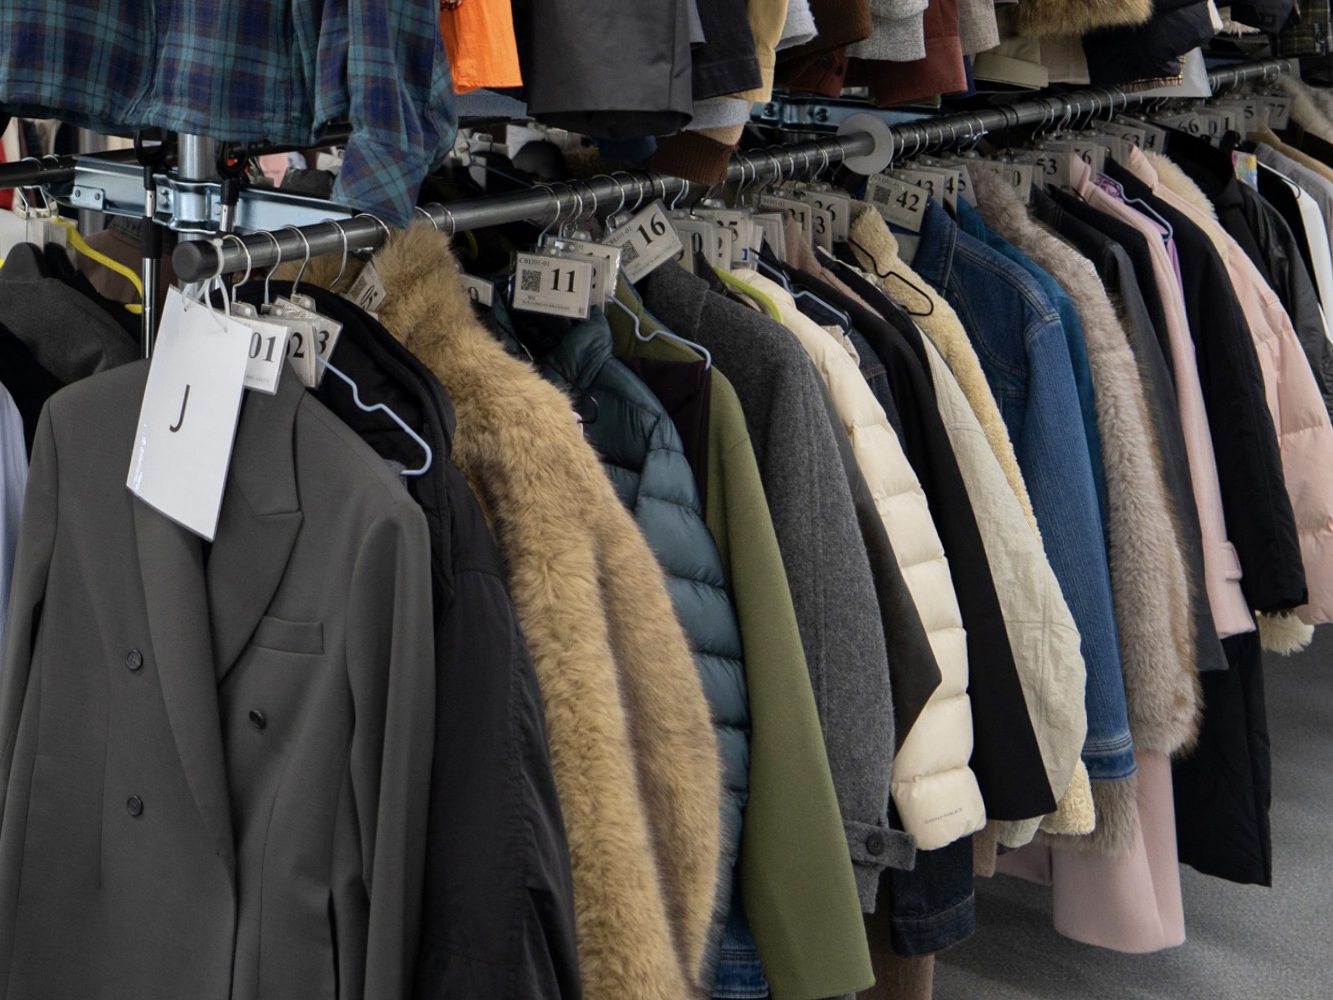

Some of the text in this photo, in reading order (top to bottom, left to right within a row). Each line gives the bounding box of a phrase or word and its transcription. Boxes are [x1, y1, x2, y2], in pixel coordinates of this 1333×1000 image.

[1244, 105, 1254, 119] 5
[1145, 133, 1156, 149] 4
[896, 190, 920, 213] 42
[636, 213, 666, 247] 16
[816, 216, 826, 235] 3
[550, 268, 577, 294] 11
[249, 331, 276, 363] 01
[169, 384, 191, 433] J
